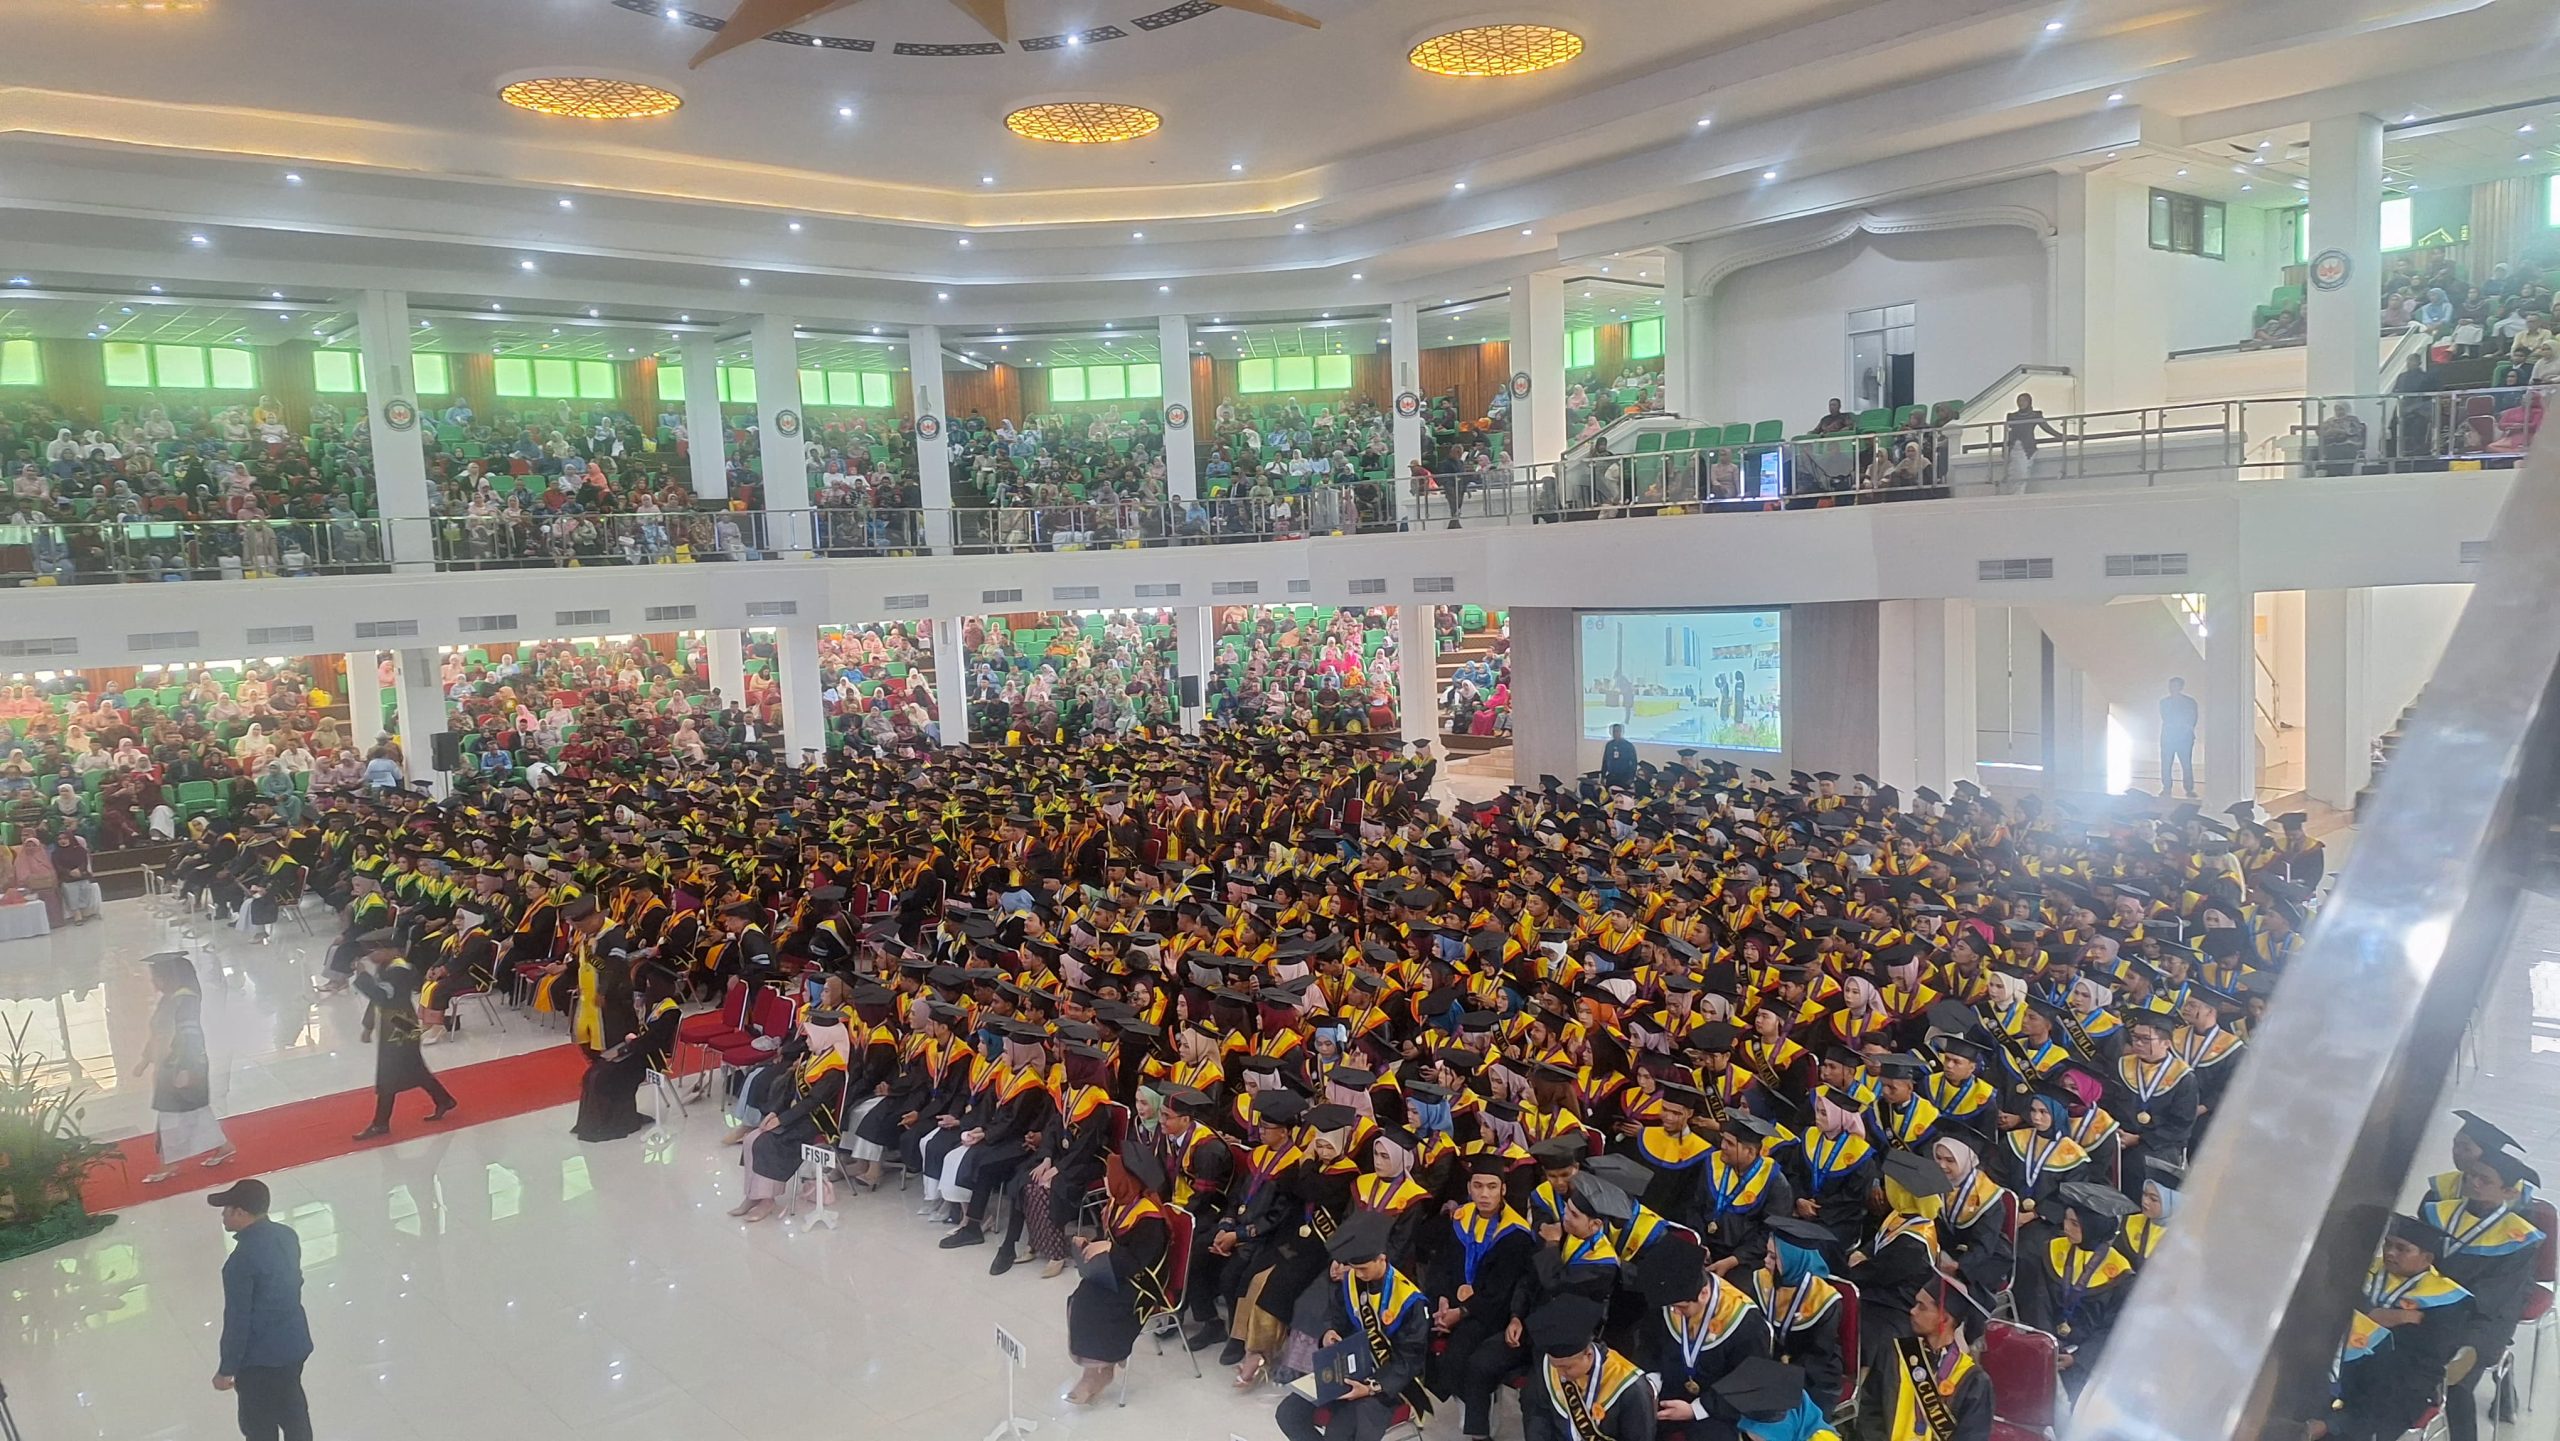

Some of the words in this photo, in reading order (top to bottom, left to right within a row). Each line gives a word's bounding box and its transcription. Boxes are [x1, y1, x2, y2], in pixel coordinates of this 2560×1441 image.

[648, 1071, 661, 1086] FEB
[805, 1147, 830, 1166] FISIP
[996, 1328, 1020, 1364] FMIPA
